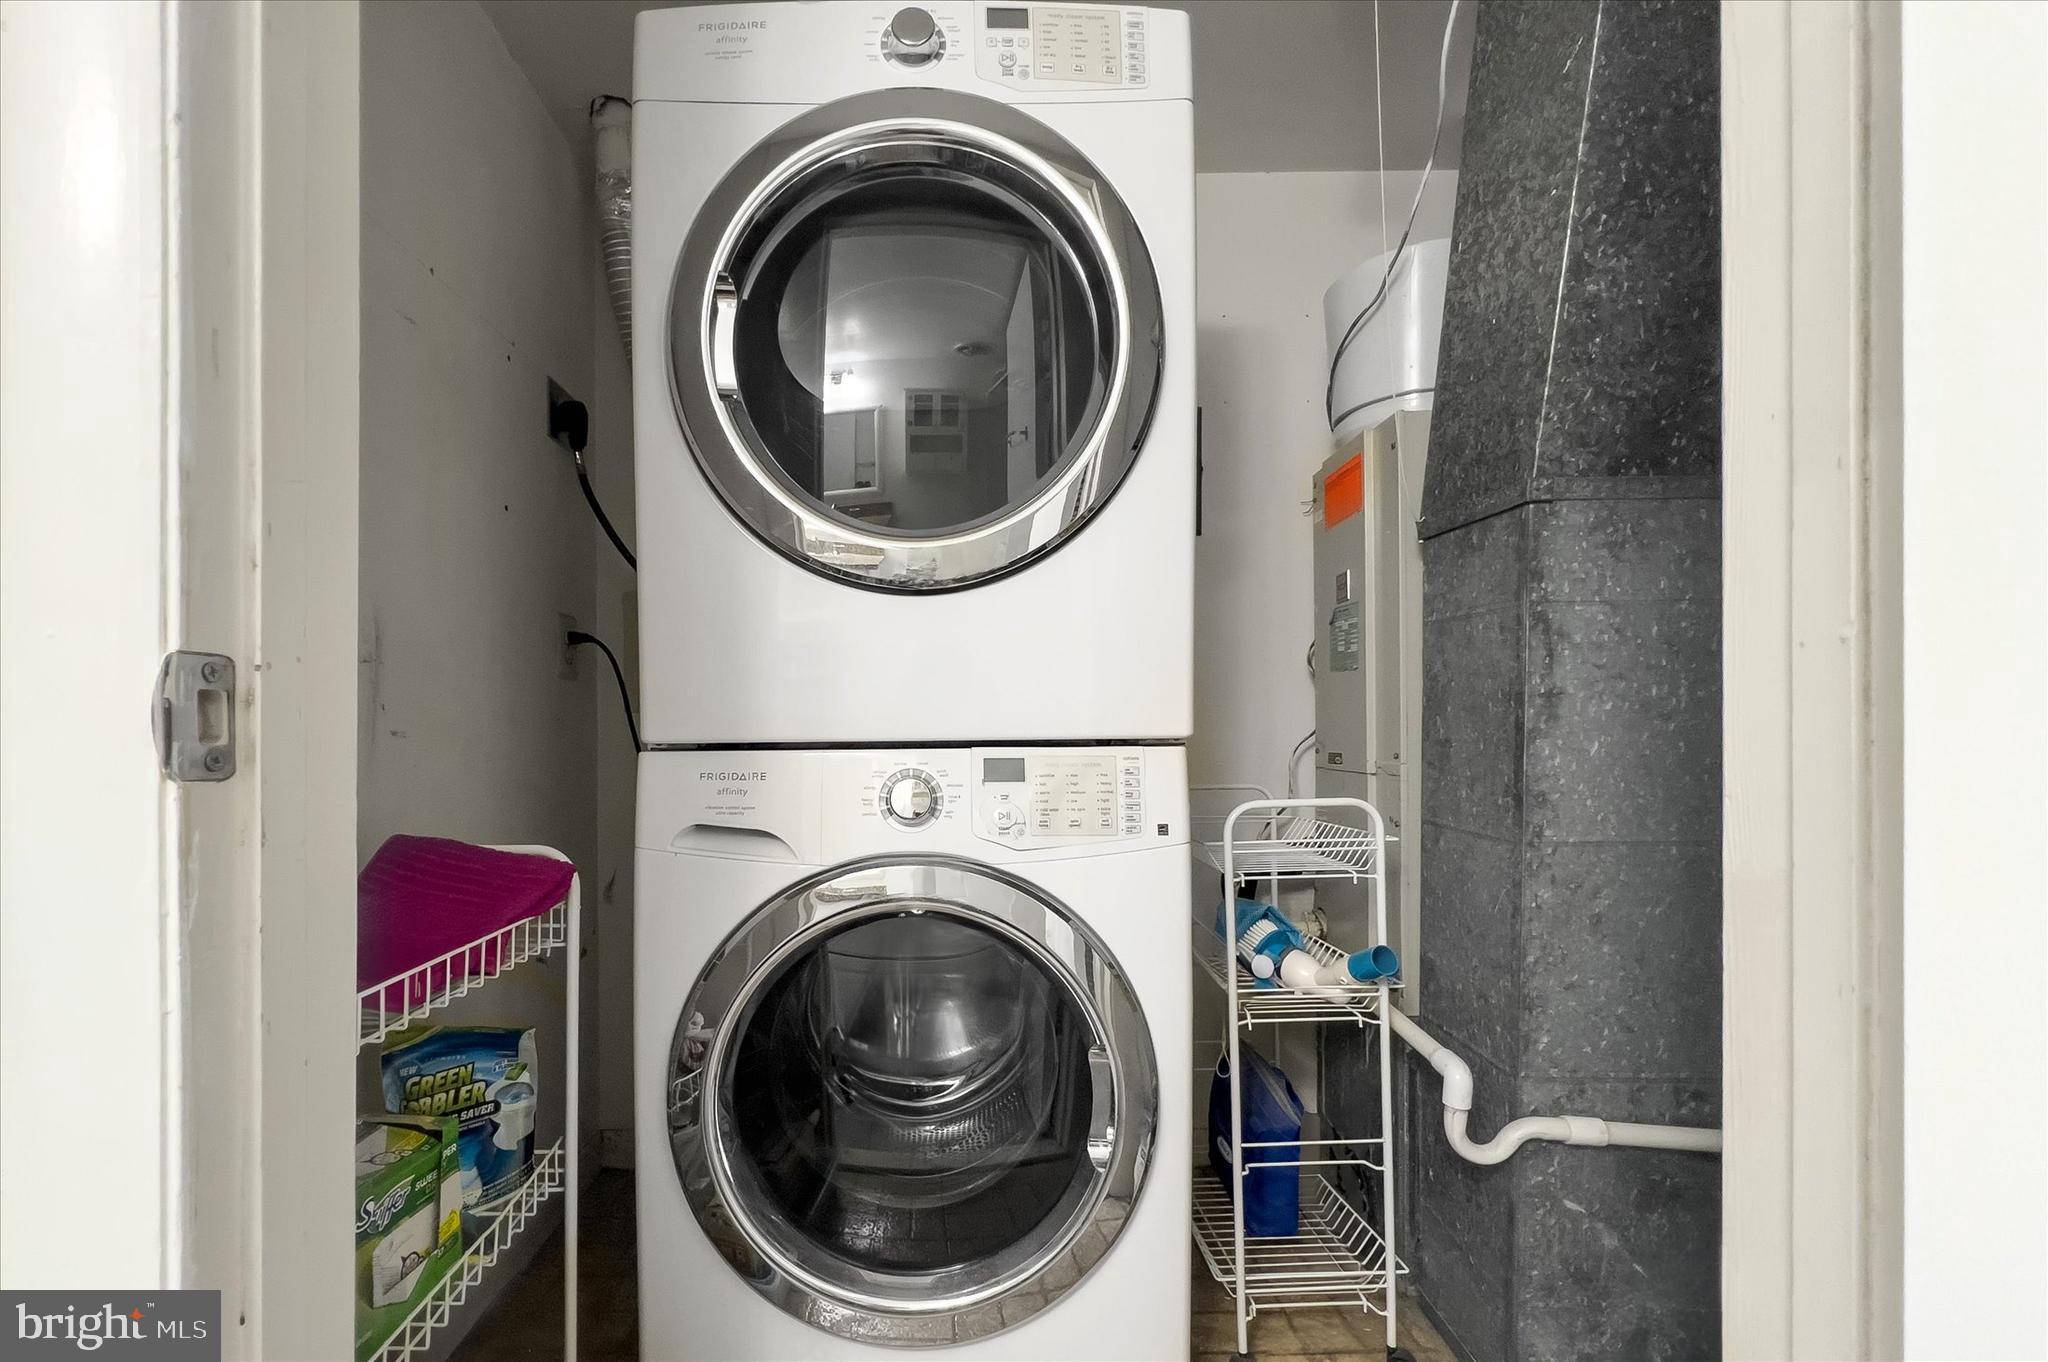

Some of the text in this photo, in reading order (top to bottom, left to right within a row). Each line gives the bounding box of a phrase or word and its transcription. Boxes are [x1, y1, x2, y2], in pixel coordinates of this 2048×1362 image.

[698, 21, 767, 31] FRIGIDAIRE
[715, 35, 748, 44] affinity
[699, 772, 767, 781] FRIGIDAIRE
[716, 787, 749, 797] affinity
[405, 1063, 474, 1099] GREEN
[460, 1103, 495, 1121] SAVER
